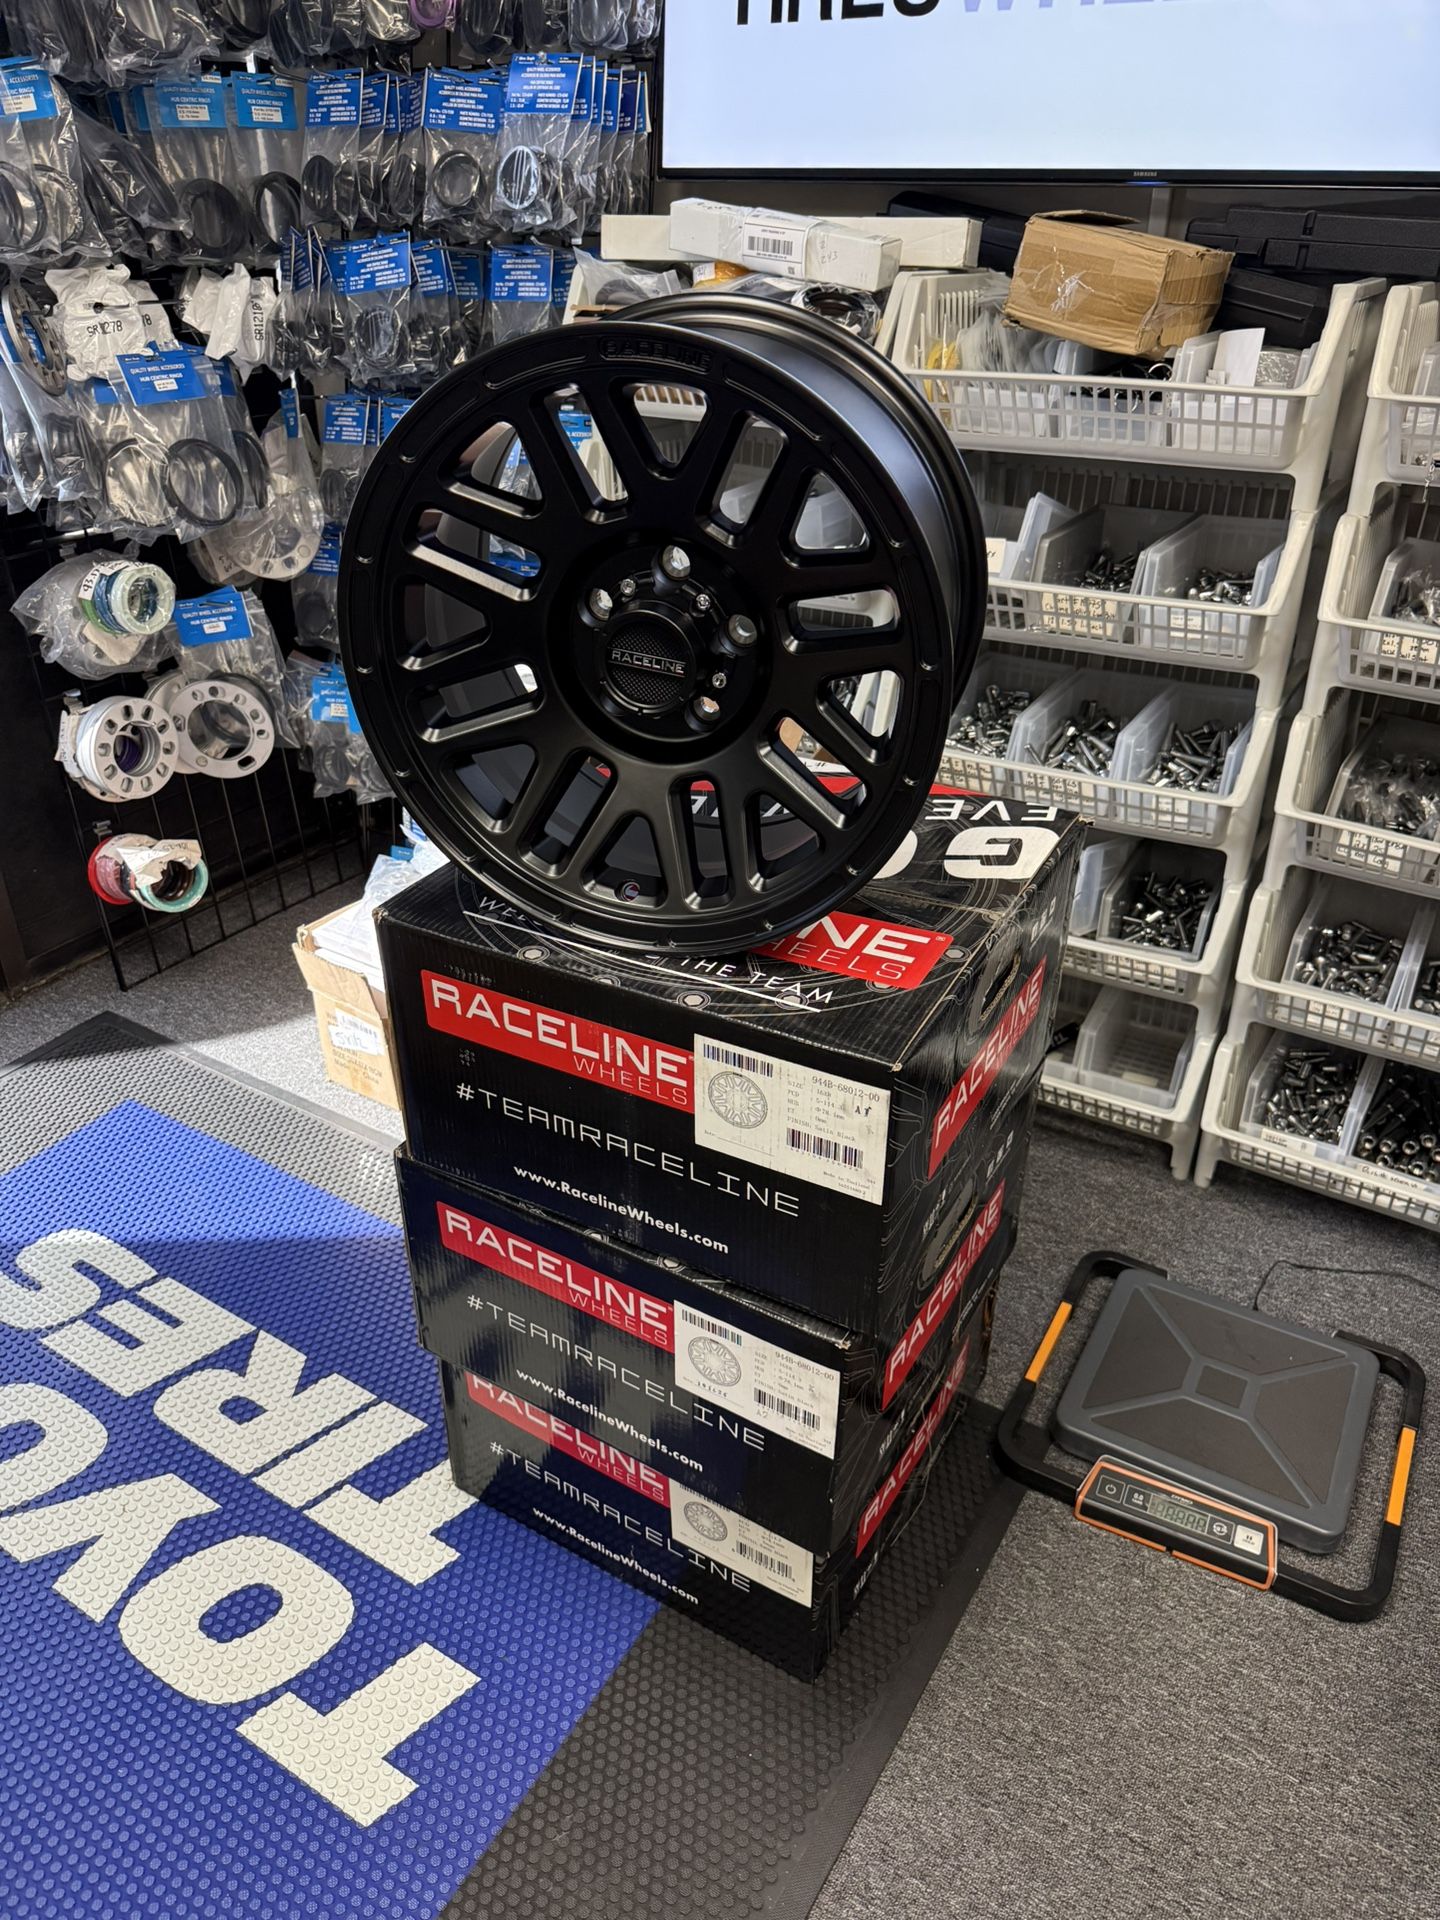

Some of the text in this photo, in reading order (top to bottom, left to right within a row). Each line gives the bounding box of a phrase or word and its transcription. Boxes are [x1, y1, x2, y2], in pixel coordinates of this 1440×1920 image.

[611, 650, 685, 674] RACELINE
[431, 978, 688, 1089] RACELINE
[750, 971, 834, 1005] TEAM
[573, 1055, 688, 1106] WHEELS
[935, 965, 1043, 1149] RACELINE
[455, 1082, 800, 1218] #TEAMRACELINE
[512, 1165, 730, 1254] www.RacelineWheels.com
[446, 1209, 668, 1332] RACELINE
[569, 1289, 668, 1346] WHEELS
[888, 1188, 1002, 1384] RACELINE
[467, 1294, 766, 1452] #TEAMRACELINE
[516, 1368, 704, 1474] www.RacelineWheels.com
[472, 1375, 664, 1491] RACELINE
[577, 1446, 665, 1502] WHEELS
[490, 1441, 751, 1593] #TEAMRACELINE
[532, 1506, 699, 1606] www.RacelineWheels.com
